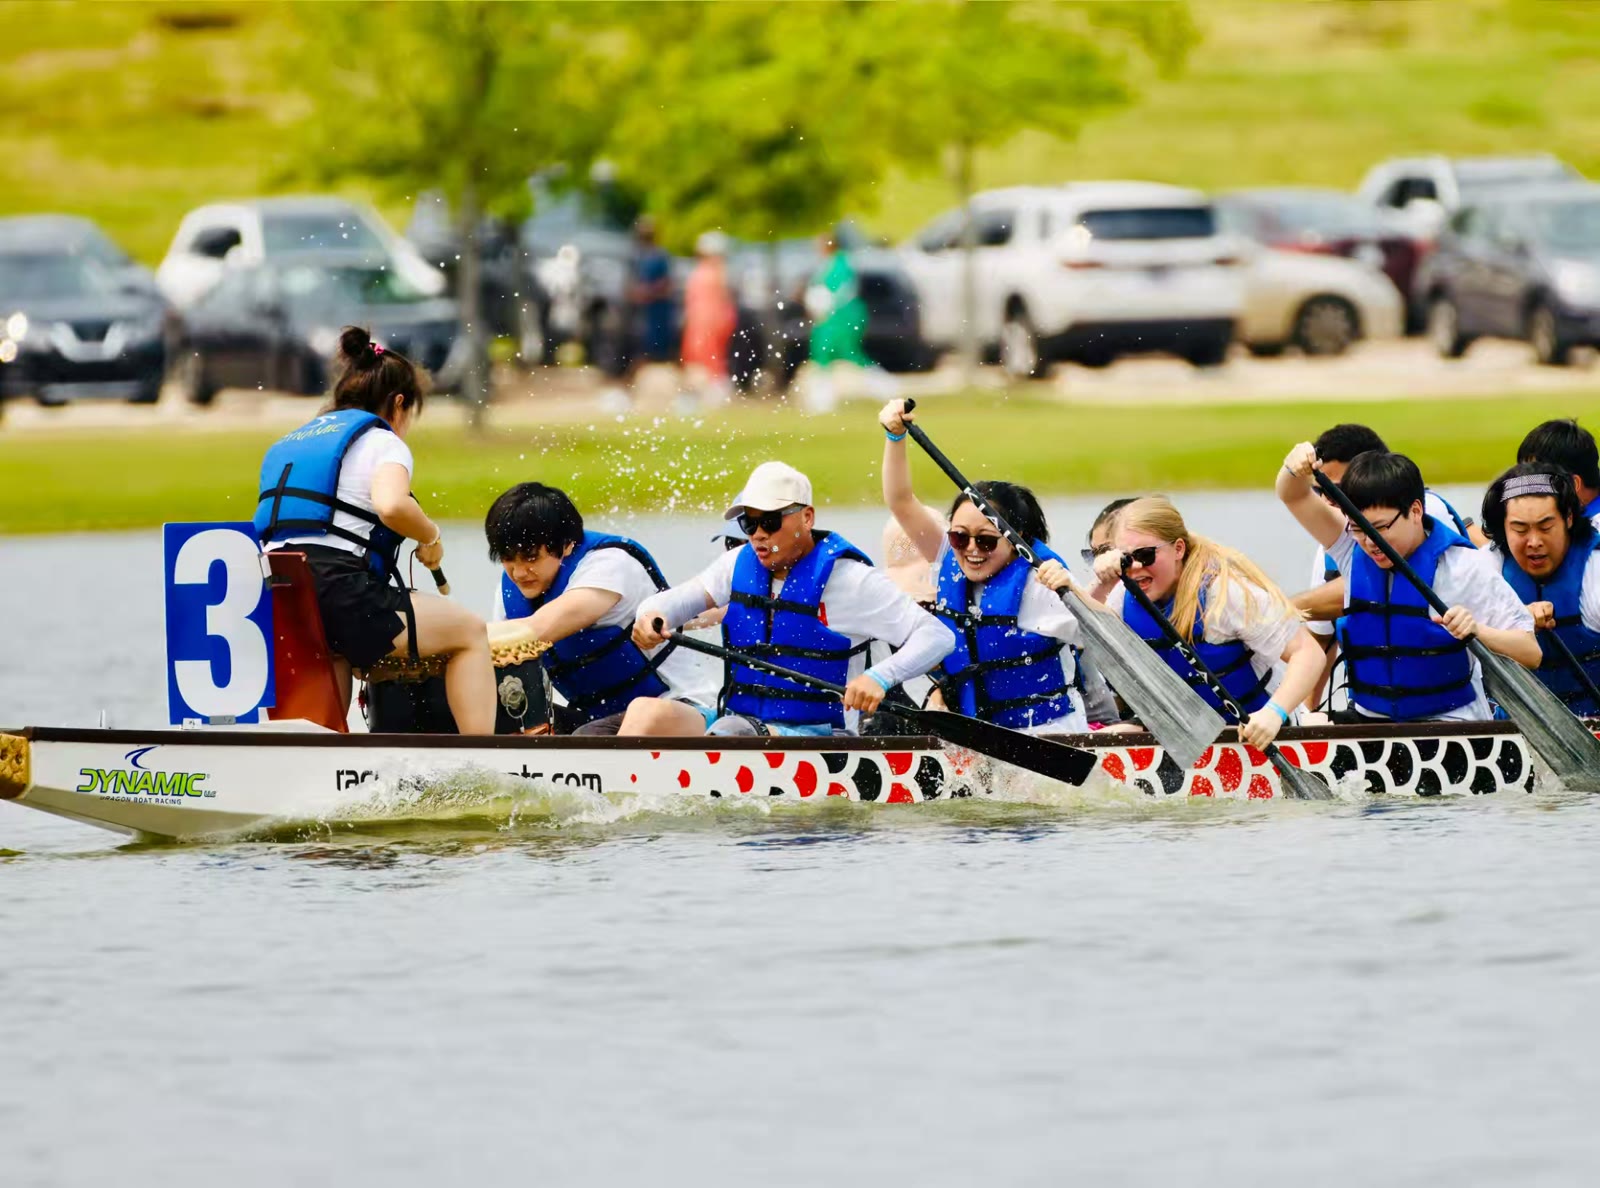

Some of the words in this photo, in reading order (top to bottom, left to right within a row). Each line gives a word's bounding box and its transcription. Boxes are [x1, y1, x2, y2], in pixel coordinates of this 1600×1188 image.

[963, 487, 1038, 570] KIALO
[174, 528, 268, 717] 3
[1174, 641, 1245, 726] KIALO
[77, 768, 206, 797] DYNAMIC
[155, 797, 182, 805] RACING
